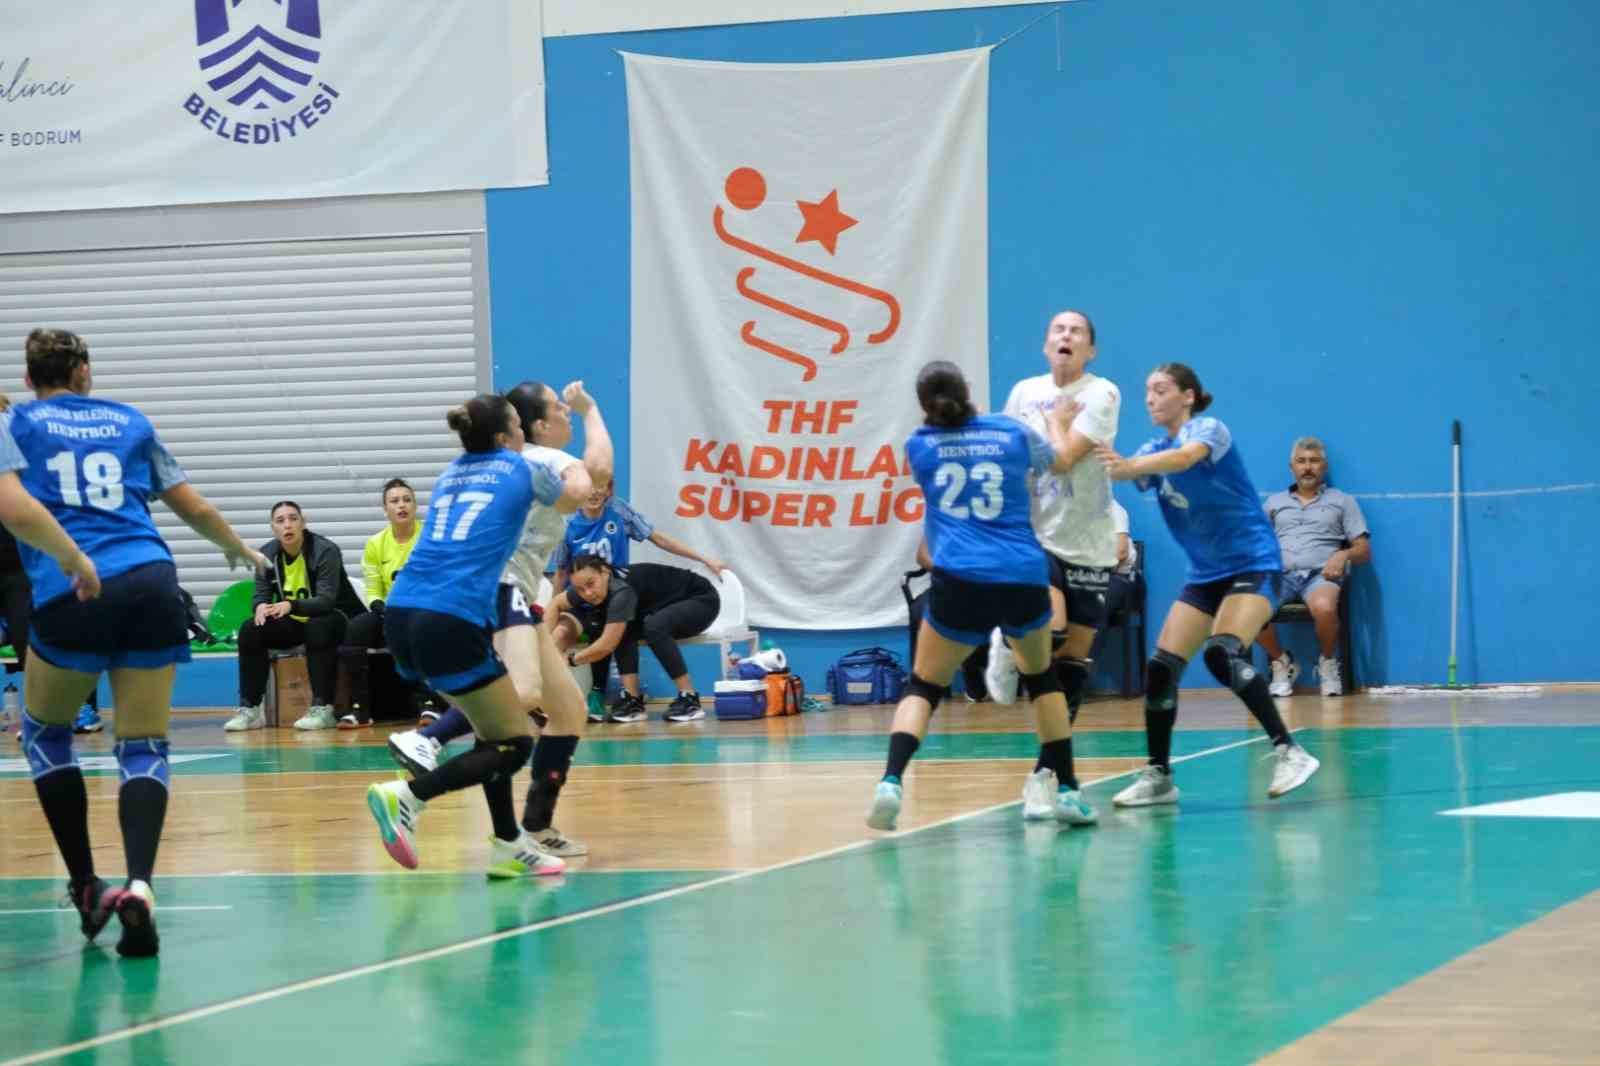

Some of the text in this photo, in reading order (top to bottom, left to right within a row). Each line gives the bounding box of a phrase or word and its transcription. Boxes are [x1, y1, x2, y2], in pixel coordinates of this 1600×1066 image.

[10, 129, 81, 147] BODRUM
[182, 82, 340, 144] BELEDİYESİ
[763, 399, 859, 434] THF
[46, 450, 124, 512] 18
[674, 477, 837, 528] SÜPER
[935, 461, 1004, 521] 23
[432, 491, 495, 541] 17
